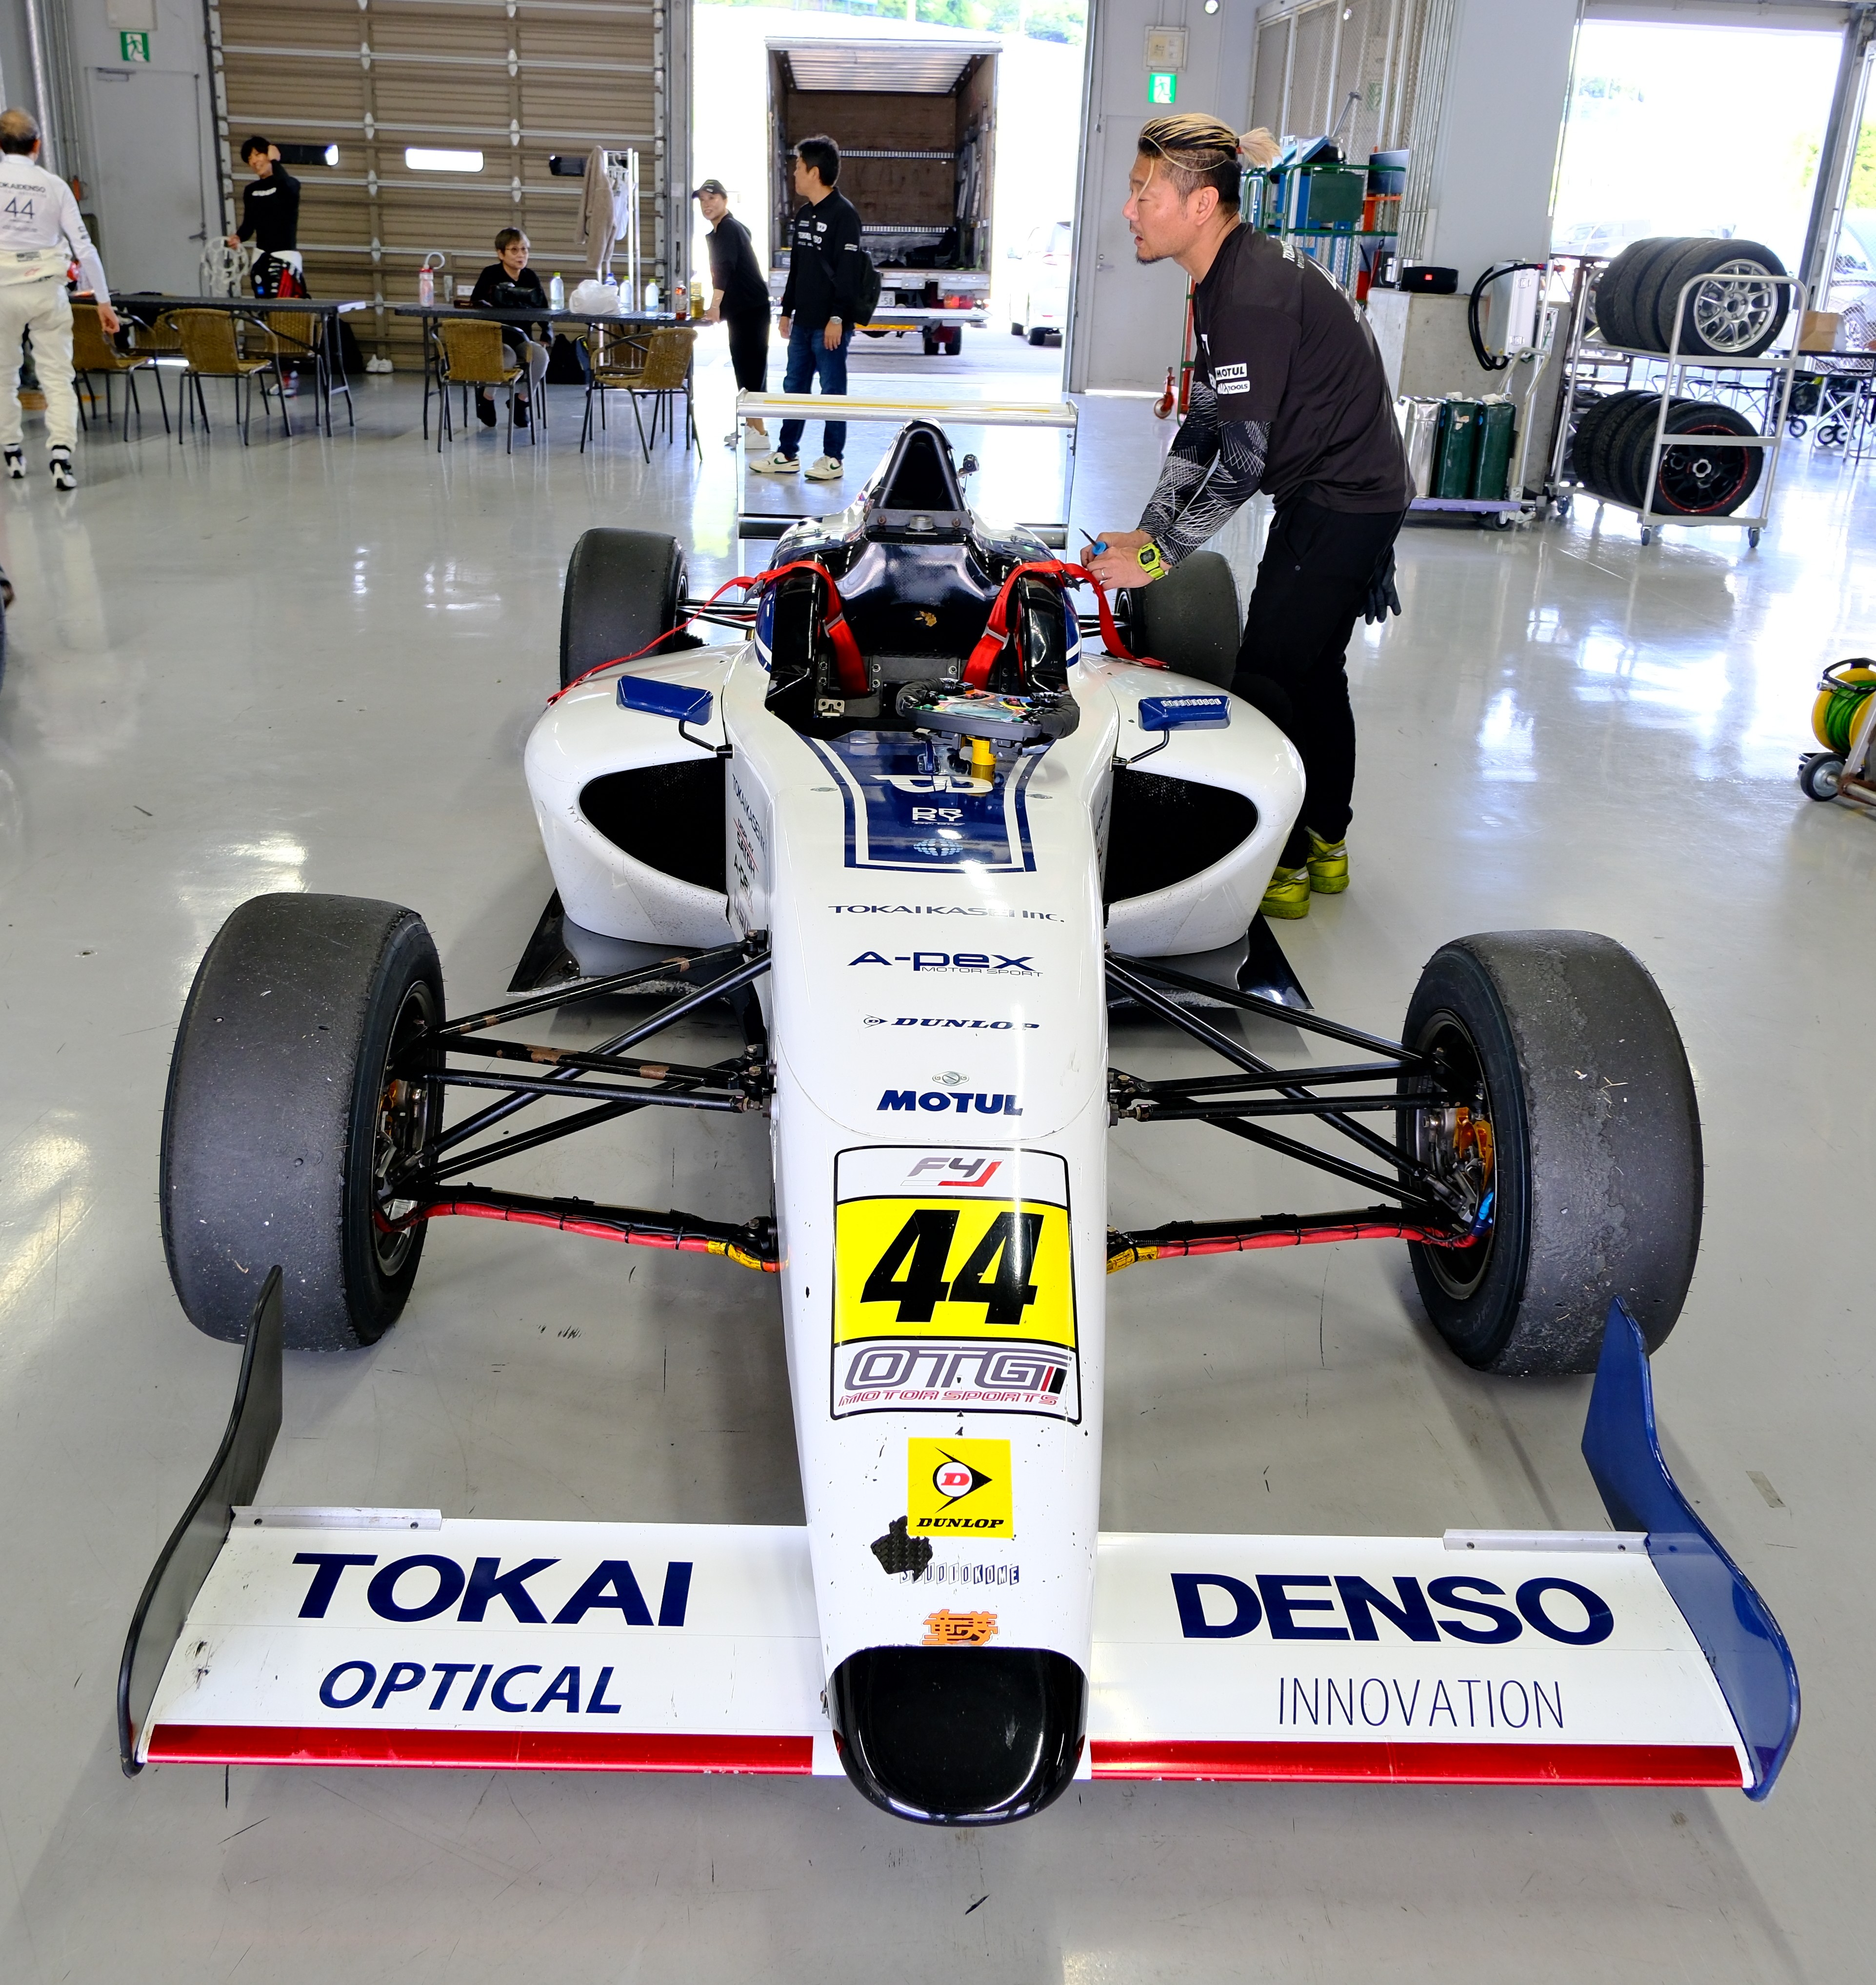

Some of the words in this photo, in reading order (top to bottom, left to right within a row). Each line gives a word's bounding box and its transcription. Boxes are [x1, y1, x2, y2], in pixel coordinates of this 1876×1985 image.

[4, 197, 35, 219] 44
[1216, 366, 1245, 378] MOTUL
[737, 831, 755, 880] SATOH
[846, 951, 1036, 971] A-pex
[891, 1017, 1040, 1030] DUNLOP
[876, 1090, 1023, 1116] MOTUL
[860, 1209, 1045, 1325] 44
[838, 1390, 939, 1407] MOTOR
[941, 1390, 1059, 1406] SPORTS
[916, 1517, 1004, 1528] DUNLOP
[900, 1562, 1019, 1585] SUDIOKOME
[292, 1552, 693, 1627] TOKAI
[1170, 1572, 1615, 1645] DENSO
[319, 1660, 622, 1714] OPTICAL
[1278, 1677, 1565, 1729] INNOVATION
